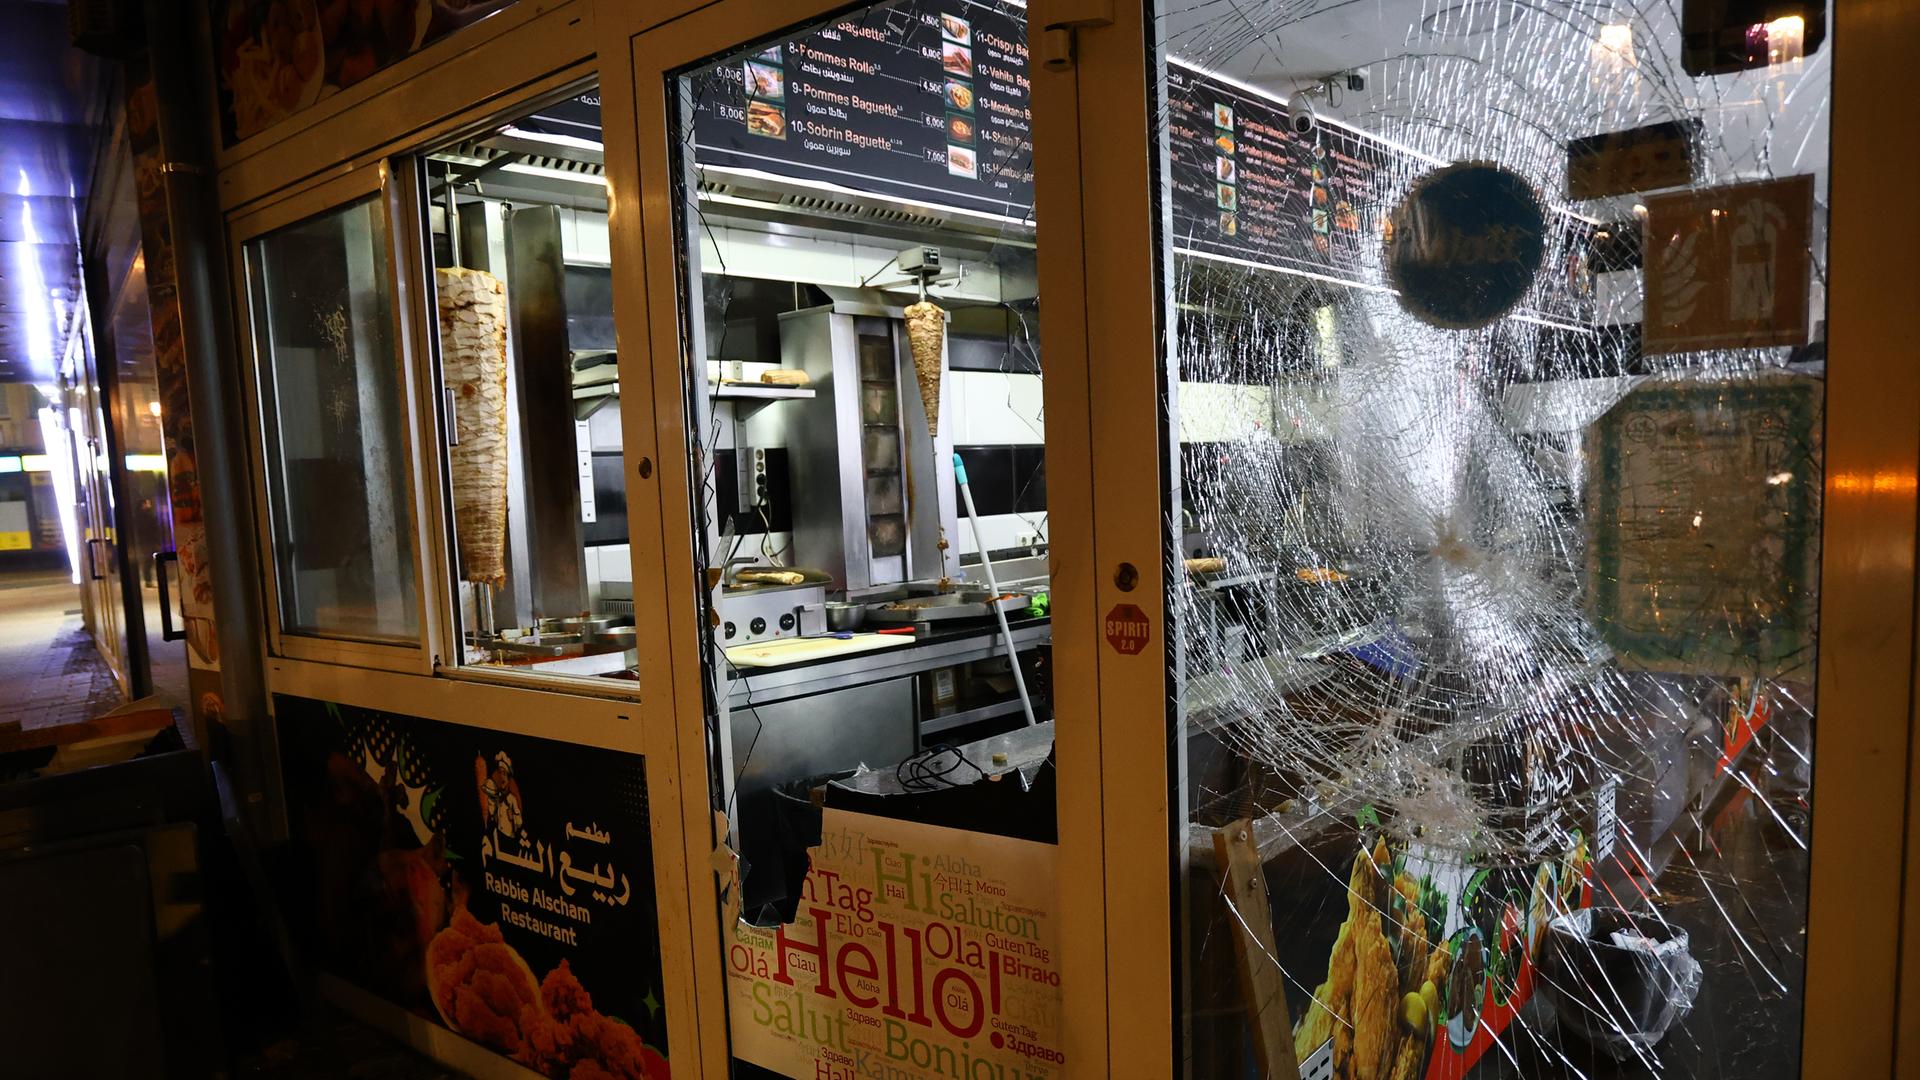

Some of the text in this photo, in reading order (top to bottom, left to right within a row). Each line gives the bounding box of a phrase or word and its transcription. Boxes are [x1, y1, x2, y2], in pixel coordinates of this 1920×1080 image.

[920, 14, 940, 28] 4,50€
[922, 46, 941, 61] 6,00€
[923, 81, 942, 94] 4,50€
[720, 106, 744, 121] 8,00€
[851, 95, 898, 118] Baguette
[925, 116, 945, 129] 6,00€
[844, 129, 892, 152] Baguette
[926, 150, 945, 164] 7,00€
[1107, 620, 1149, 638] SPIRIT
[1121, 639, 1135, 650] 2.0
[565, 821, 611, 845] مطعم
[481, 827, 631, 907] ربيع الشام
[933, 854, 981, 878] Aloha
[869, 847, 939, 916] Hi
[886, 884, 905, 900] Hai
[933, 872, 975, 896] 今日は
[975, 880, 1006, 897] Mono
[485, 872, 591, 924] Rabbie Alscham
[817, 869, 874, 923] Tag
[501, 903, 577, 946] Restaurant
[835, 912, 864, 938] Elo
[939, 892, 1042, 941] Saluton
[866, 927, 882, 938] Ciao
[924, 922, 986, 970] Ola
[985, 932, 1050, 964] Guten Tag
[730, 944, 770, 979] Olá
[788, 952, 817, 974] Ciau
[1003, 954, 1060, 987] Вітаю
[771, 905, 1005, 1050] Hello!
[856, 978, 880, 994] Aloha
[946, 994, 969, 1012] Olá
[752, 981, 853, 1054] Salut
[846, 1007, 882, 1029] Здраво
[990, 1017, 1038, 1041] Guten Tag
[821, 1046, 855, 1068] Здраво
[882, 1017, 1044, 1080] Bonjou
[1006, 1033, 1065, 1065] Здраво
